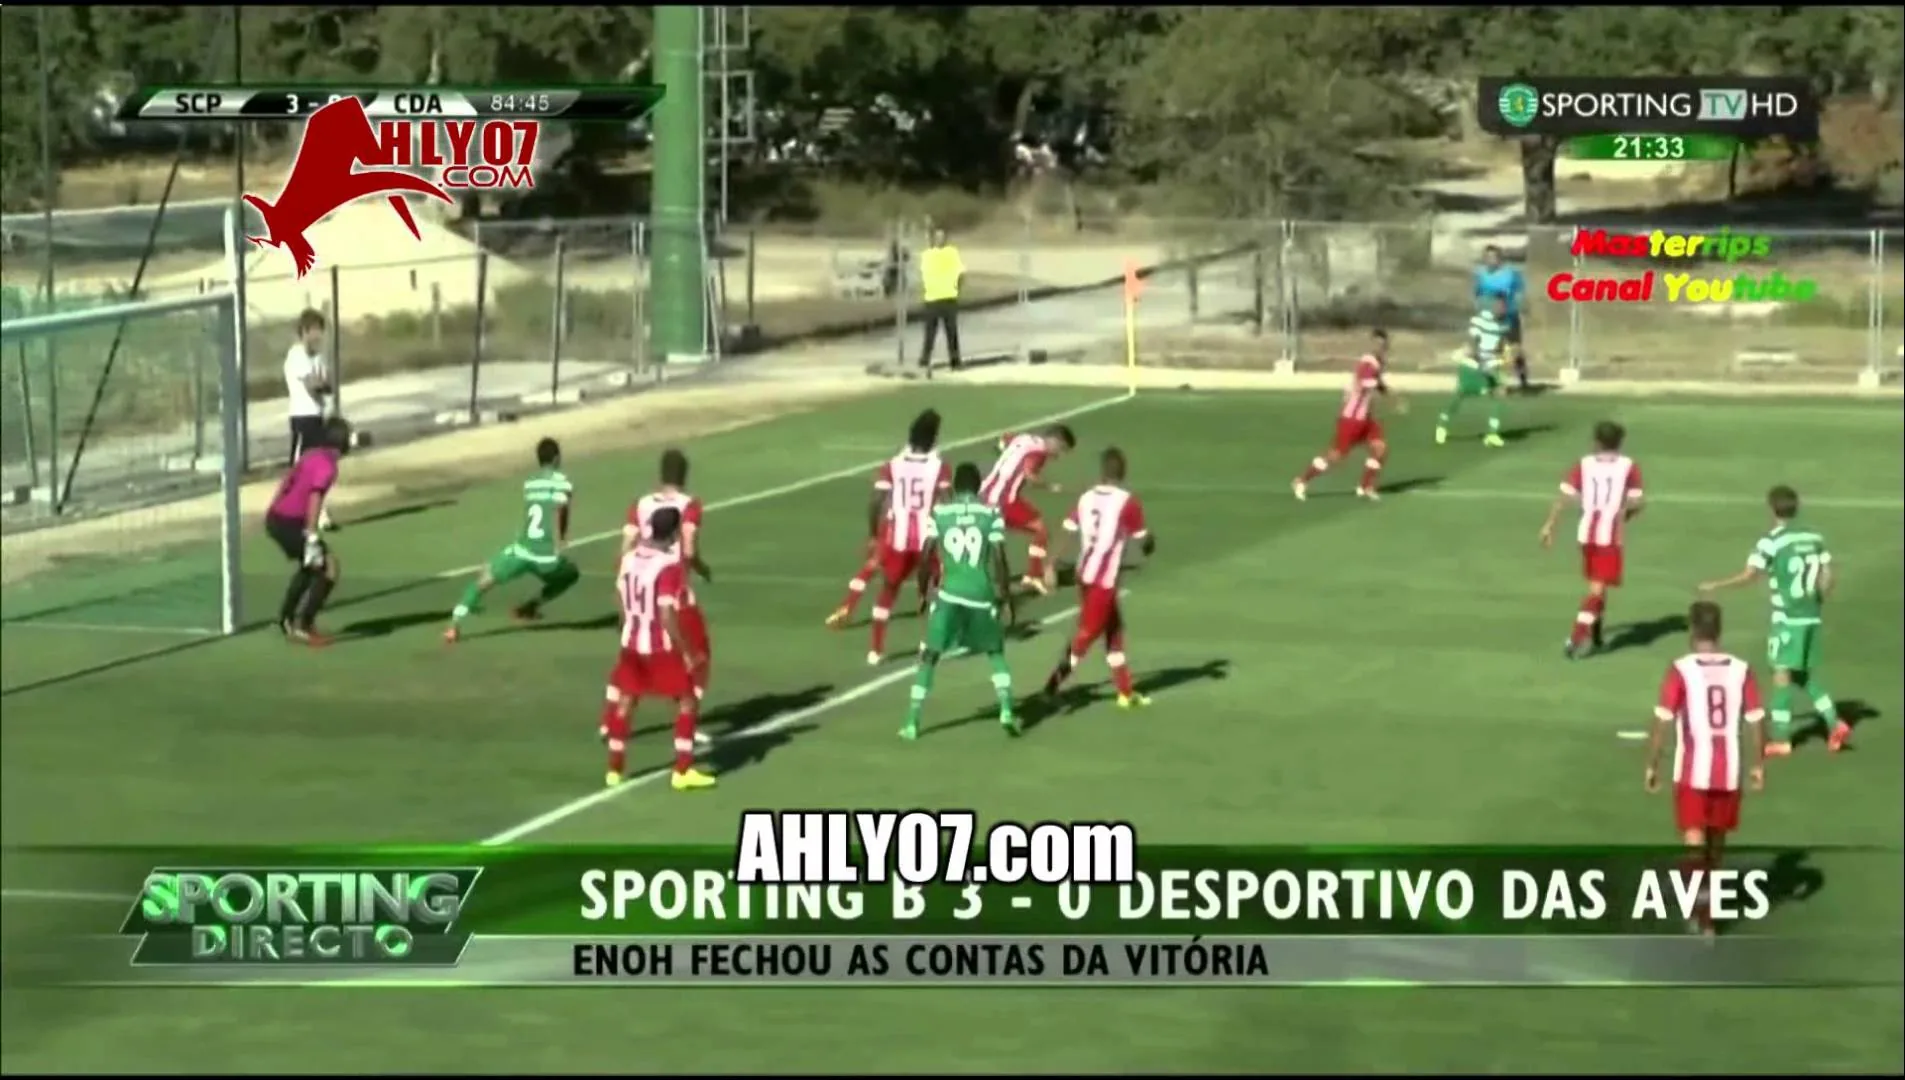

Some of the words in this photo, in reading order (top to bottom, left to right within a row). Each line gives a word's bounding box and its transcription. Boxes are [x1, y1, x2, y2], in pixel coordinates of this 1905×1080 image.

[899, 477, 925, 511] 15
[1592, 476, 1613, 505] 11
[527, 503, 545, 539] 2
[943, 526, 983, 568] 99
[623, 573, 648, 614] 14
[1787, 553, 1820, 598] 27
[1707, 684, 1726, 730] 8
